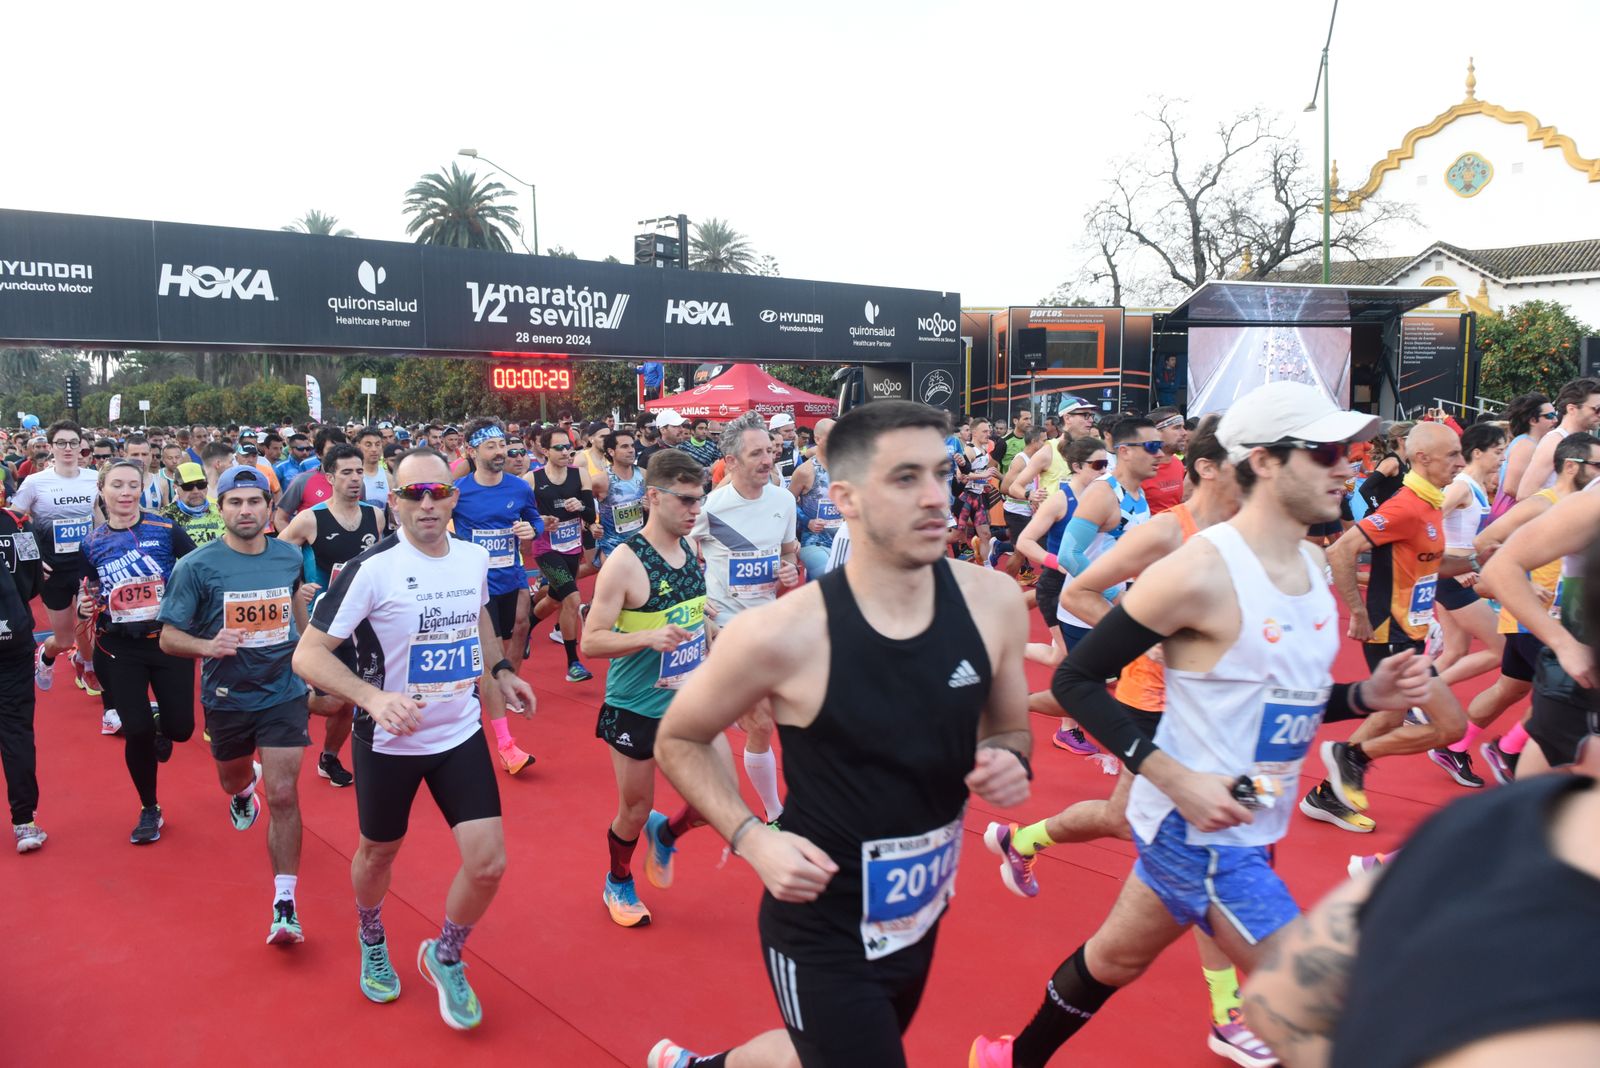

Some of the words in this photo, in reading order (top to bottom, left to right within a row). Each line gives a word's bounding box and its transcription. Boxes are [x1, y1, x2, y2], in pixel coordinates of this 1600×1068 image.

[0, 260, 93, 279] YUNDAI
[58, 283, 93, 293] Motor
[158, 263, 275, 301] HOKA
[335, 315, 380, 326] Healthcare
[381, 317, 411, 327] Partner
[665, 299, 731, 326] HOKA
[779, 312, 824, 324] HYUNDAI
[515, 332, 529, 343] 28
[532, 334, 563, 344] enero
[565, 334, 592, 346] 2024
[494, 369, 569, 389] 00:00:29
[53, 496, 92, 506] LEPAPE
[60, 525, 87, 538] 2019
[555, 526, 576, 540] 1525
[480, 538, 507, 551] 2802
[736, 560, 769, 577] 2951
[118, 585, 152, 602] 1375
[416, 593, 433, 601] CLUB
[446, 588, 477, 598] ATLETISMO
[235, 603, 278, 623] 3618
[418, 610, 478, 633] Legendarios
[420, 646, 466, 672] 3271
[669, 643, 700, 668] 2086
